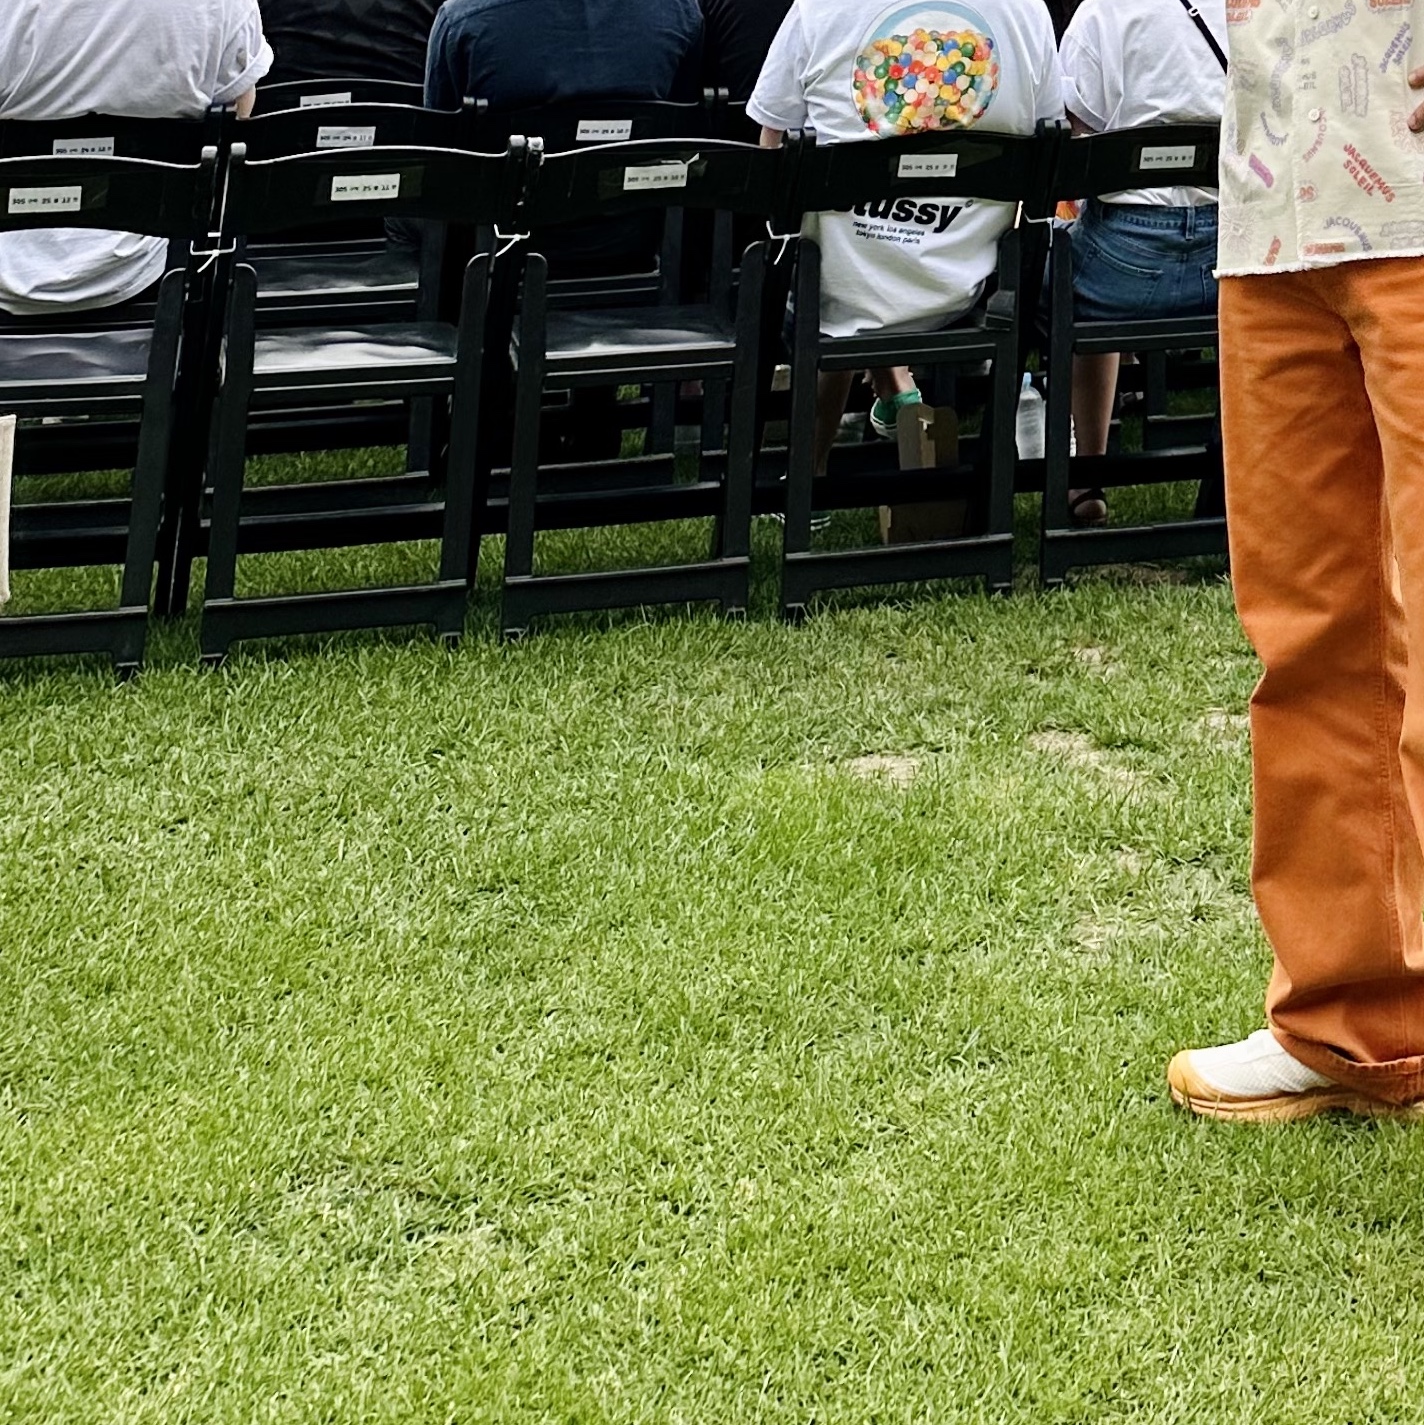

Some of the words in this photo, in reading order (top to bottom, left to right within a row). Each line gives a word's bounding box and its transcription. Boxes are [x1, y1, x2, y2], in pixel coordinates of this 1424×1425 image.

[1343, 143, 1396, 204] JACQUEMUS
[1343, 159, 1374, 197] SOLEIL
[851, 197, 962, 234] tussy
[1323, 216, 1374, 252] JACQUEMUS
